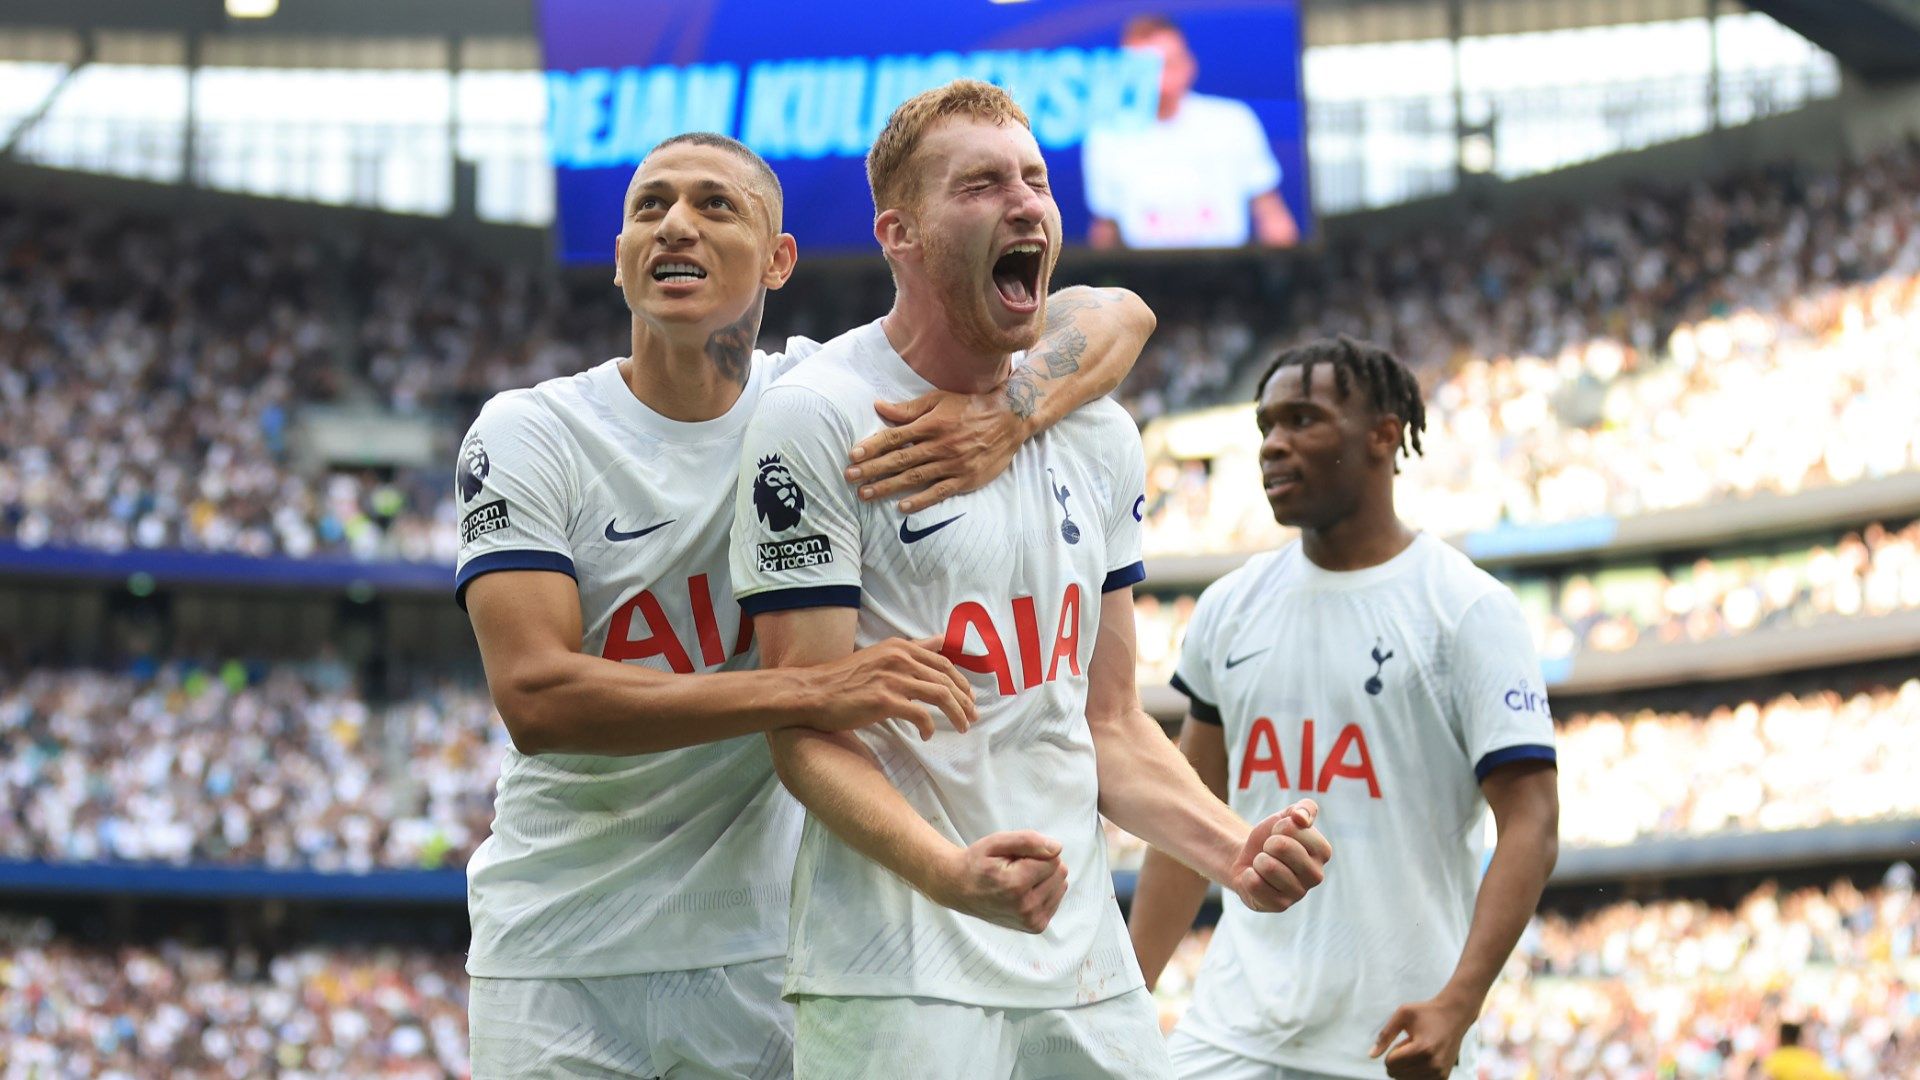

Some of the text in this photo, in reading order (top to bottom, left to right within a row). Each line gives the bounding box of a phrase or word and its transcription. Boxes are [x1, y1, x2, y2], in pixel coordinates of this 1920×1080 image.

[469, 505, 500, 528] room
[470, 516, 510, 541] racism
[757, 539, 822, 560] No room
[757, 550, 833, 571] For racism
[938, 583, 1081, 696] AIA
[1238, 717, 1382, 799] AIA
